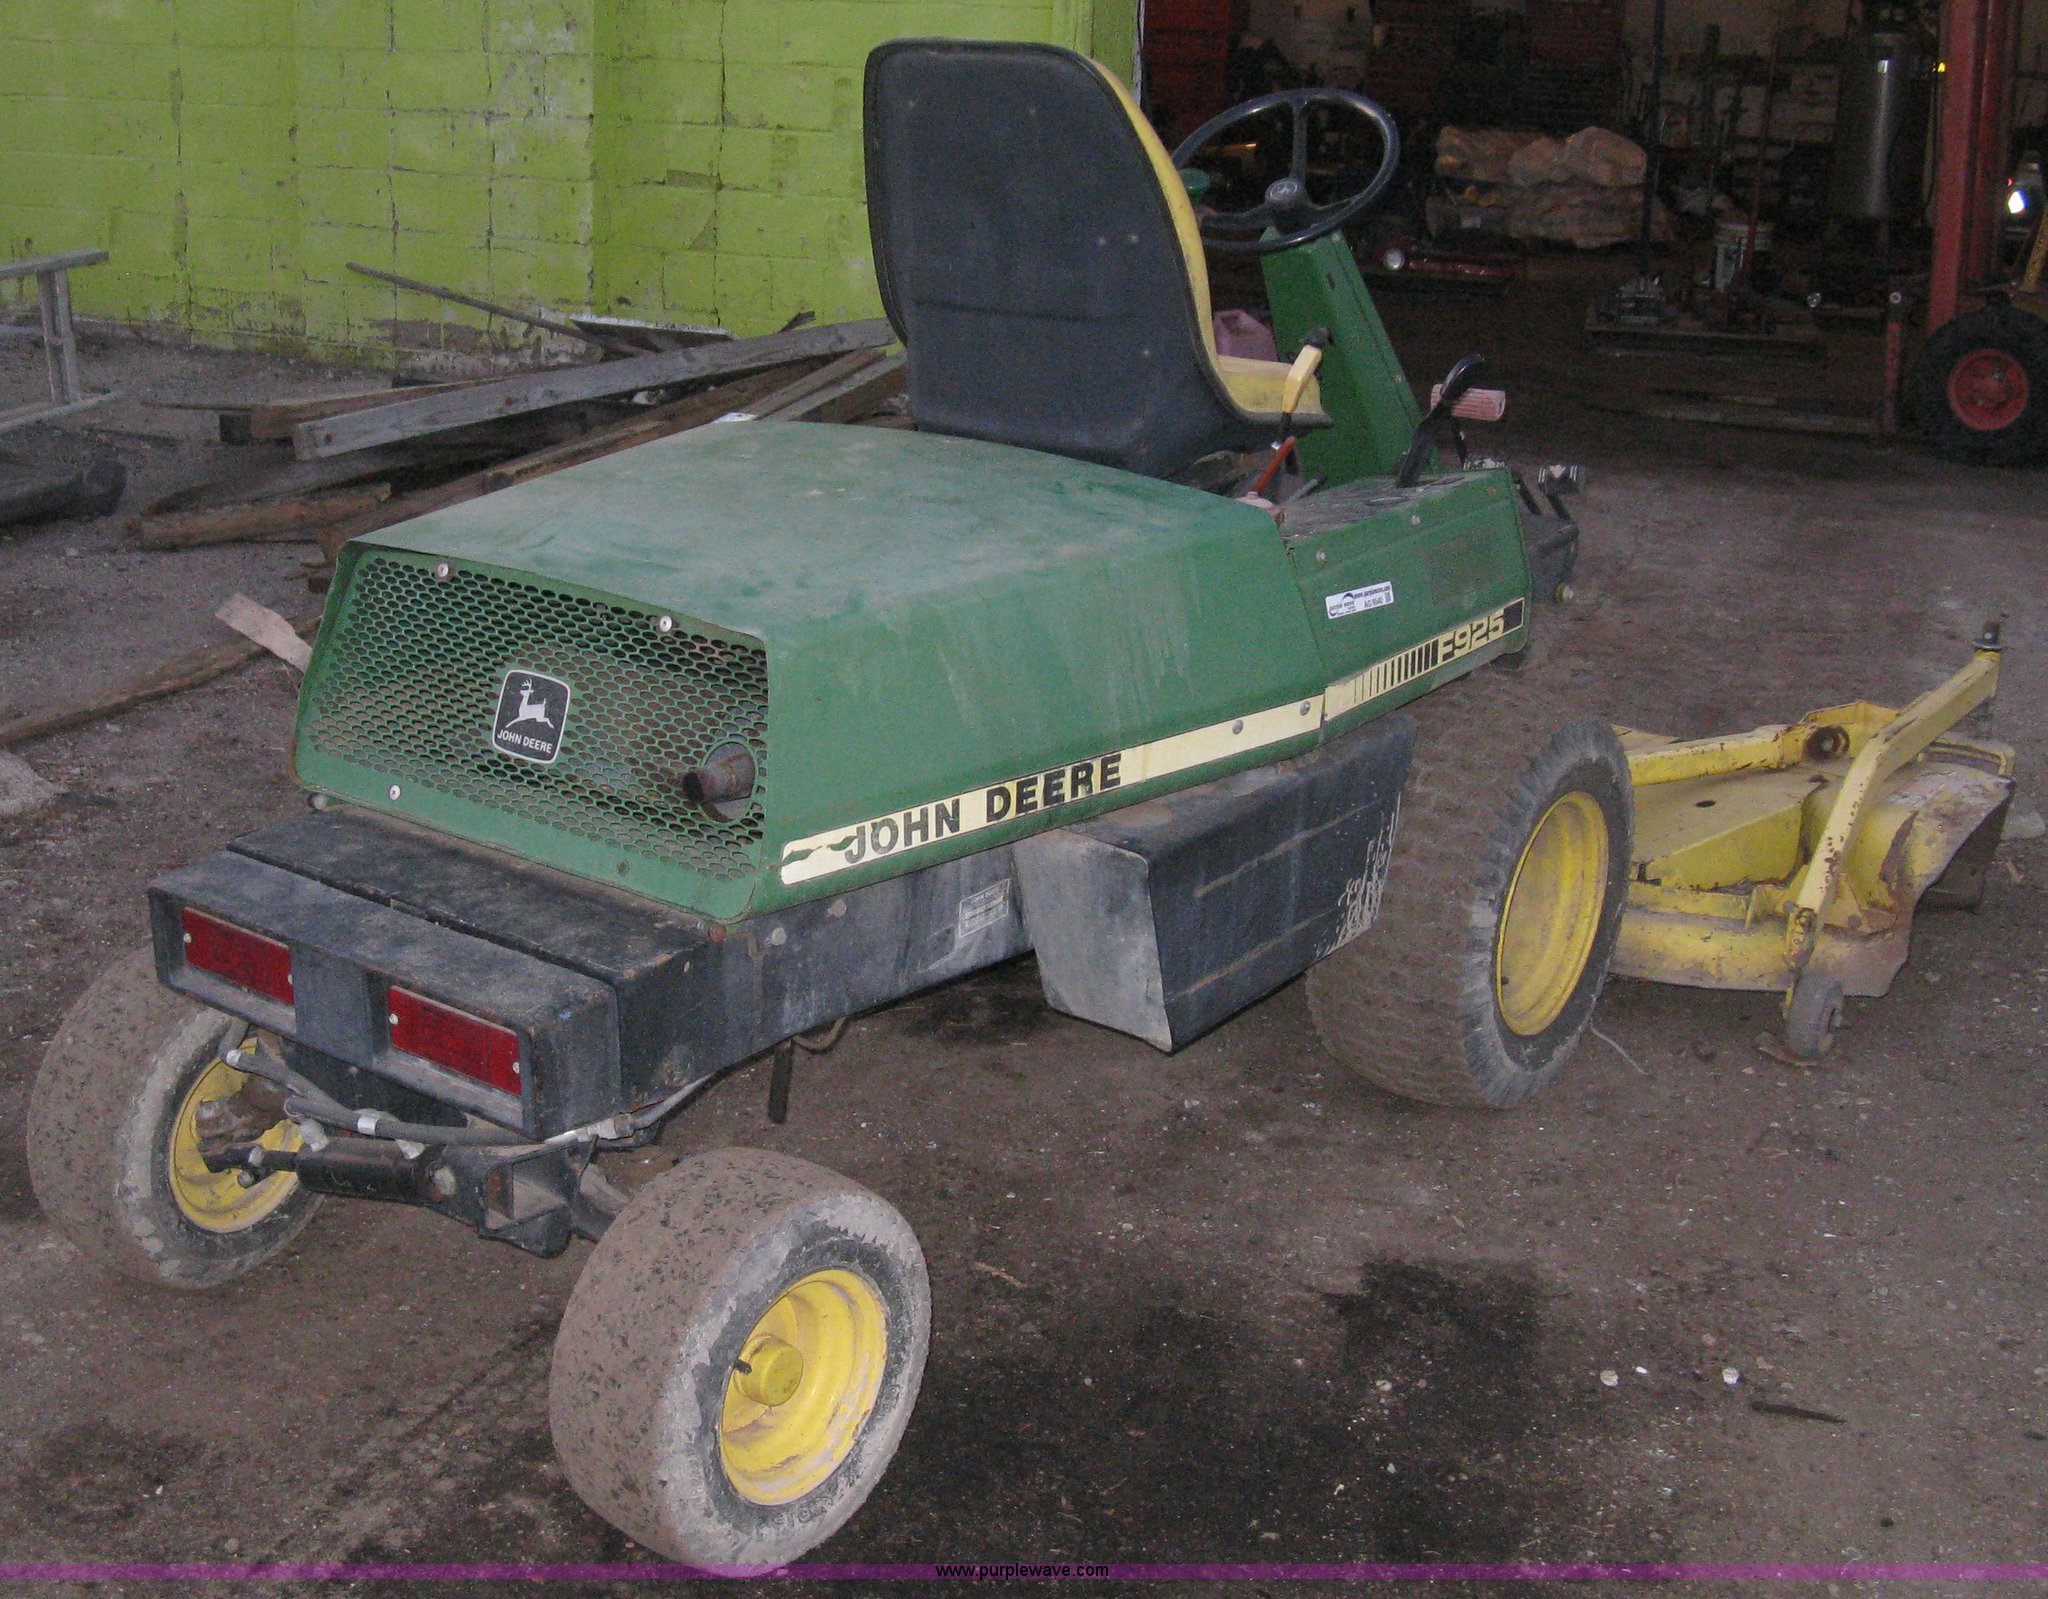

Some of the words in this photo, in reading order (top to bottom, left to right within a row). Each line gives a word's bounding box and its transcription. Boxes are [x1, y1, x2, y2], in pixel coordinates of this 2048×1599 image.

[497, 729, 521, 745] JOHN
[523, 736, 553, 754] DEERE
[844, 798, 960, 864] JOHN
[986, 753, 1121, 822] DEERE
